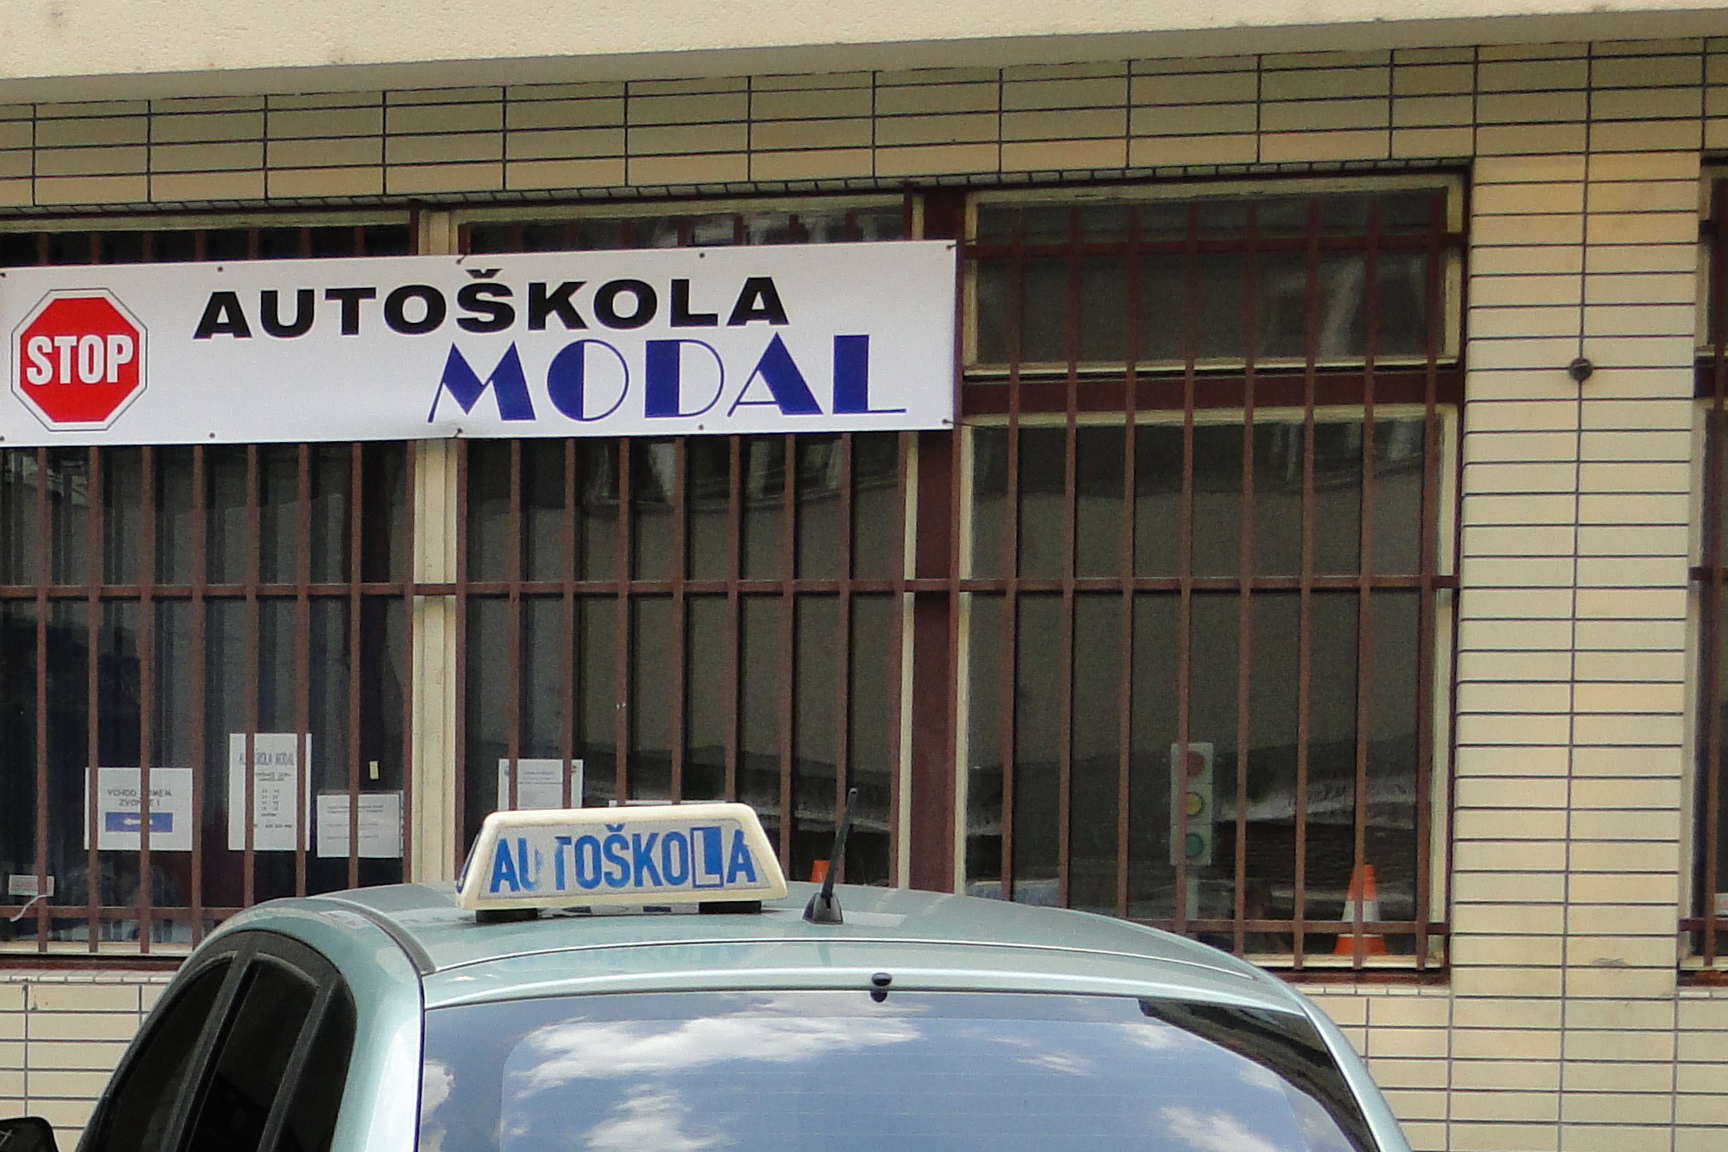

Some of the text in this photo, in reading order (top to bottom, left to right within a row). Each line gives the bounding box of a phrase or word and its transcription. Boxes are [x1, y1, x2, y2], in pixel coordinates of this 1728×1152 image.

[193, 269, 791, 340] AUTOŠKOLA
[26, 334, 134, 386] STOP
[427, 331, 907, 423] MODAL
[489, 824, 757, 893] AUTOŠKOLA
